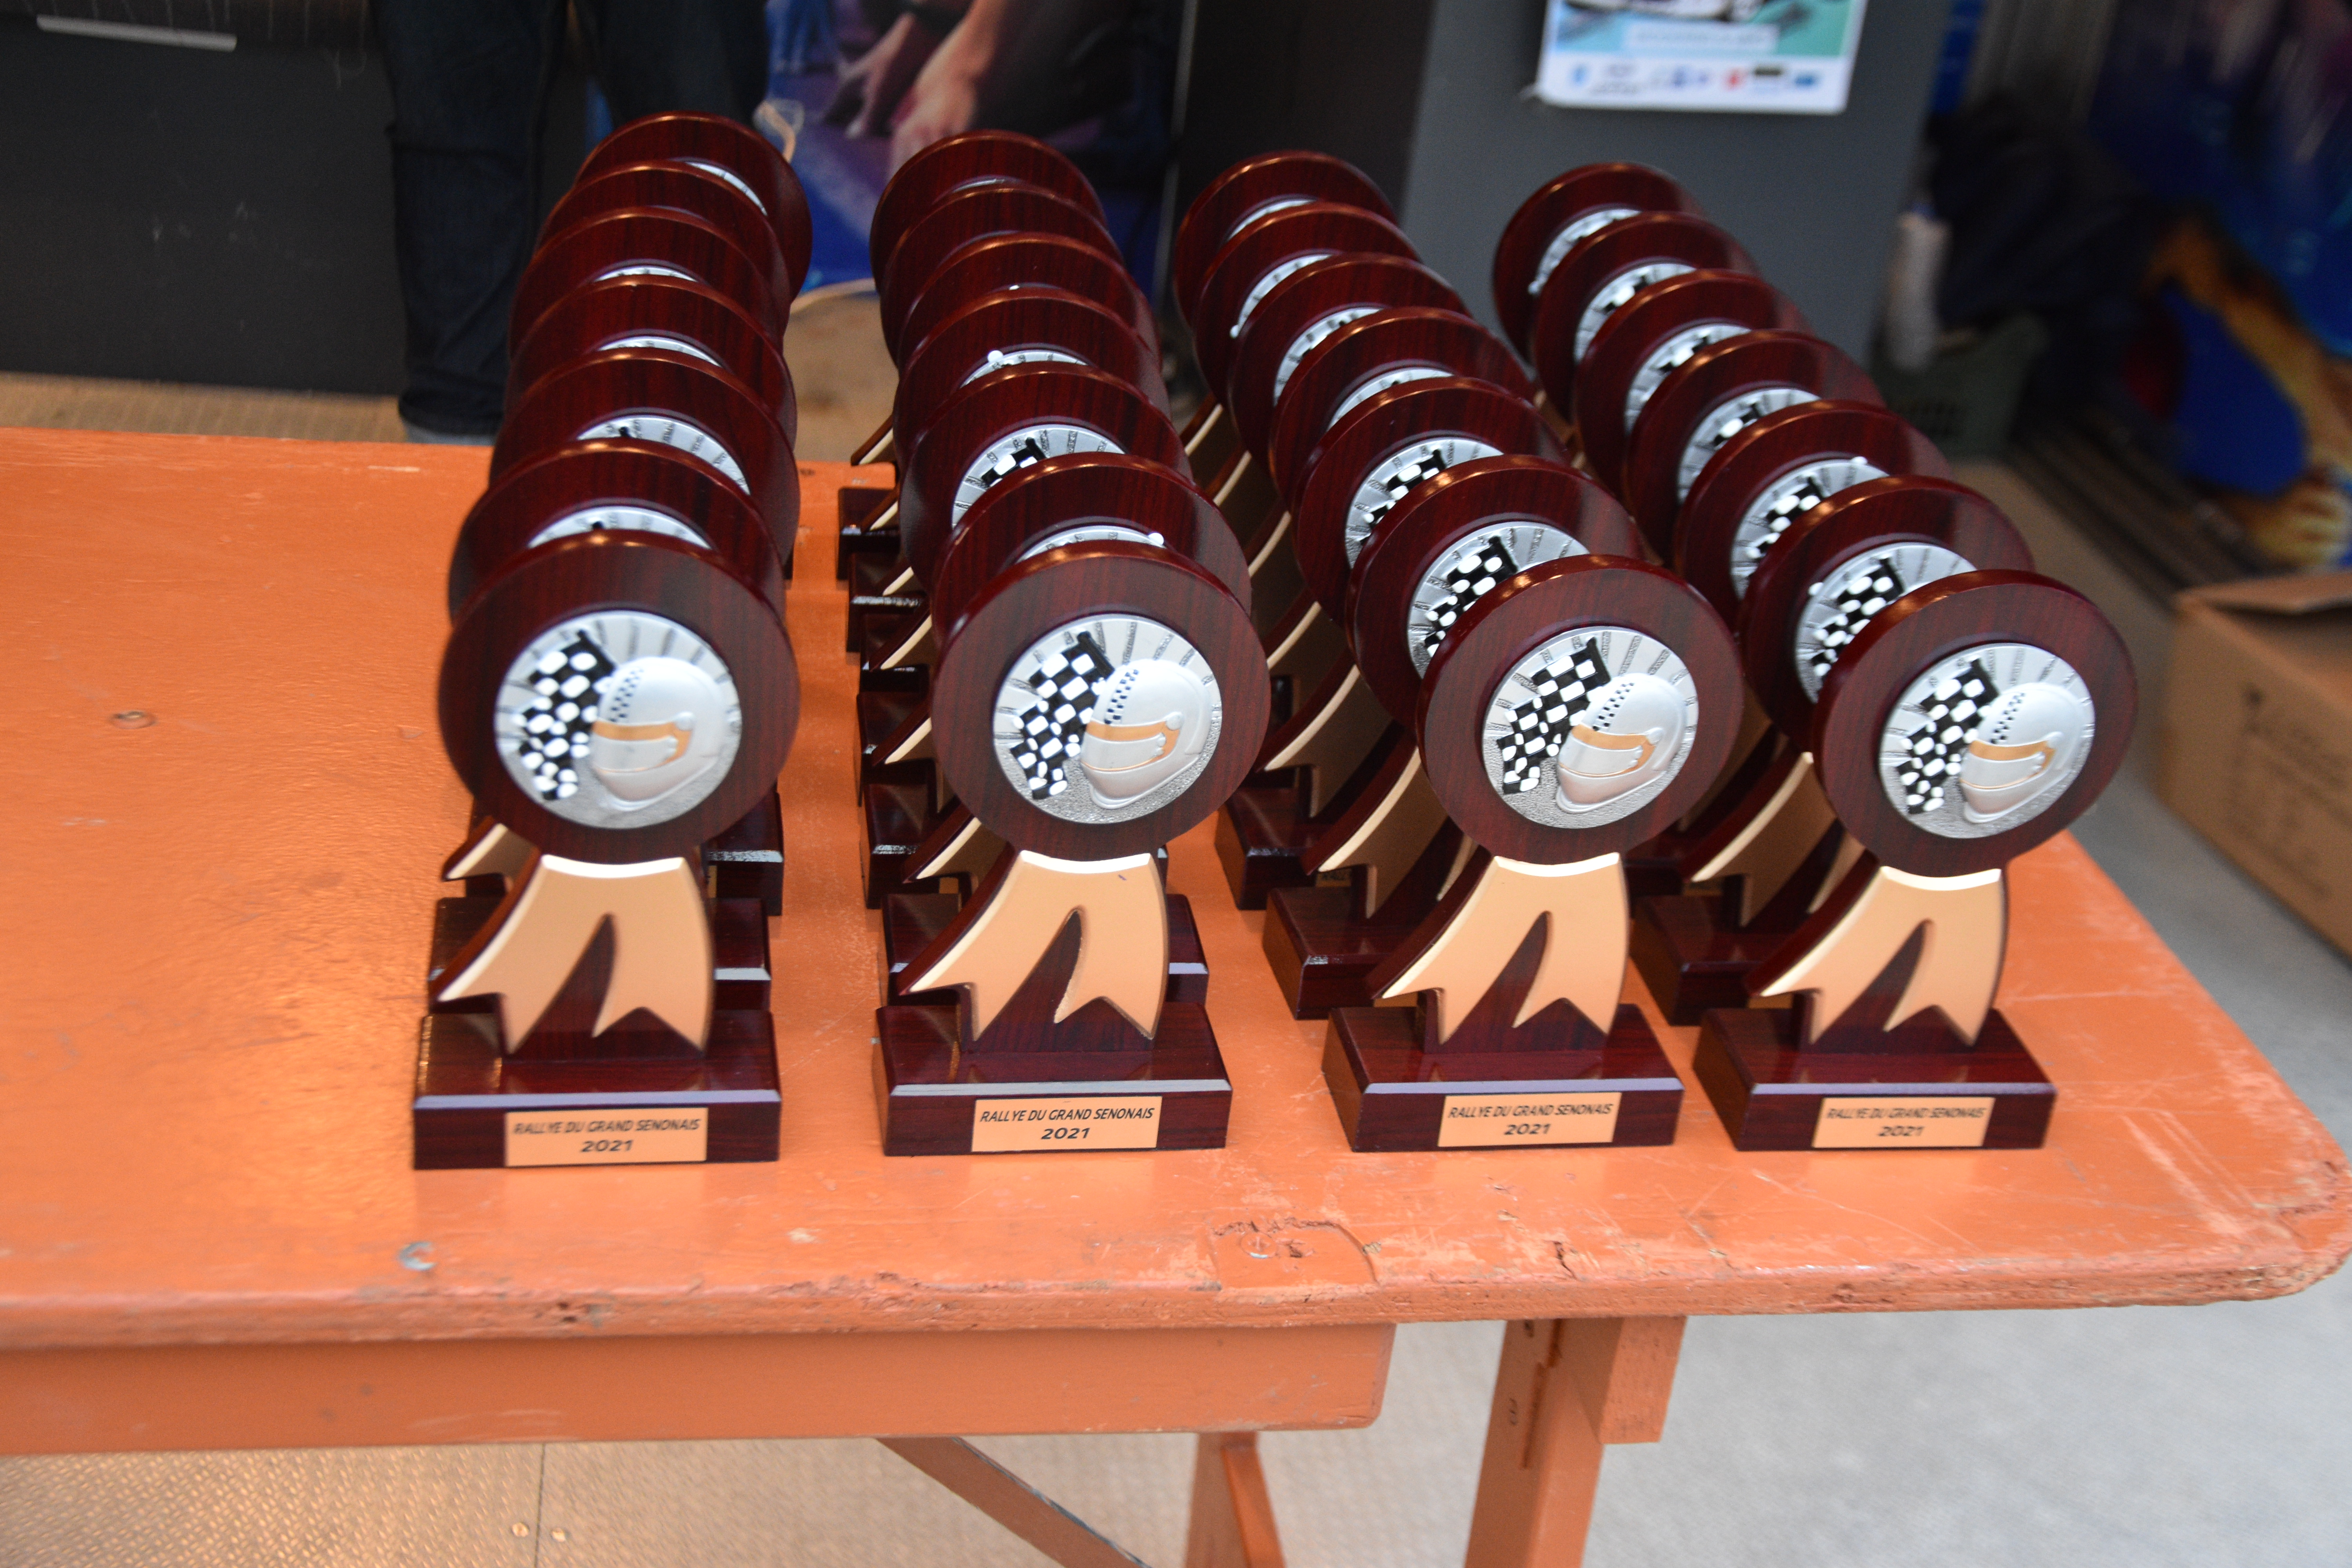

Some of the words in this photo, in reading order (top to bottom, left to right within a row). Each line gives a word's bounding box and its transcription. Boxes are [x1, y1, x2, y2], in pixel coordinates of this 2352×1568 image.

[980, 1110, 1027, 1122] RALLYE
[1028, 1110, 1047, 1121] DU
[1049, 1109, 1092, 1120] GRAND
[1093, 1108, 1155, 1119] SENONAIS
[1448, 1107, 1492, 1118] RALLYE
[1493, 1106, 1512, 1117] DU
[1513, 1105, 1553, 1116] GRAND
[1555, 1103, 1613, 1115] SENONAIS
[514, 1122, 562, 1134] RALLYE
[565, 1122, 584, 1133] DU
[587, 1120, 633, 1132] GRAND
[635, 1118, 701, 1131] SENONAIS
[1504, 1123, 1551, 1135] 2021
[1041, 1127, 1090, 1140] 2021
[581, 1140, 633, 1152] 2021
